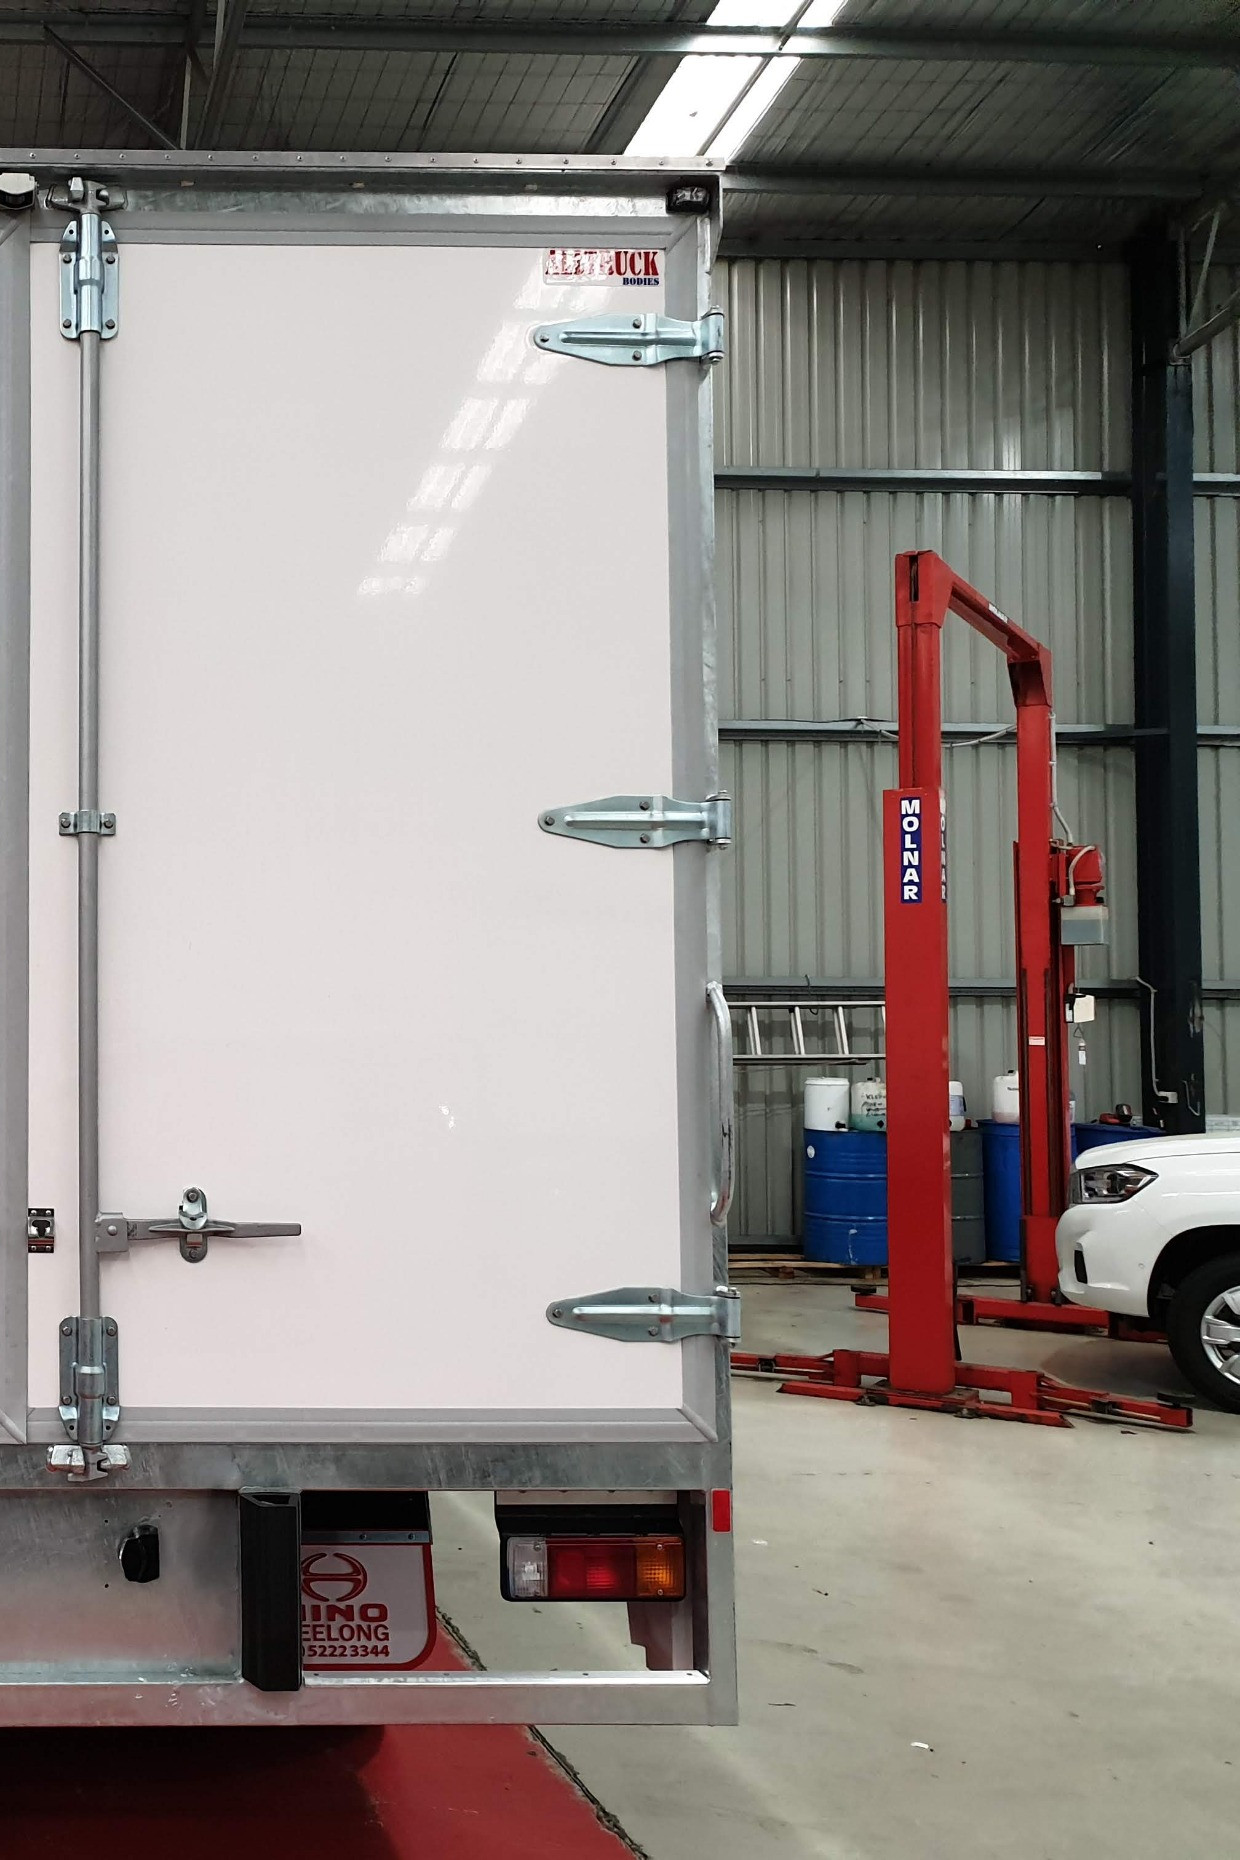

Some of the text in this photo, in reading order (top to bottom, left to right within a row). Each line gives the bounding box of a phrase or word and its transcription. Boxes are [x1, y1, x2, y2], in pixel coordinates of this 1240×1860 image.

[622, 277, 660, 286] BODIES
[901, 799, 921, 900] MOLNAR
[301, 1603, 389, 1622] INO
[301, 1624, 390, 1641] EELONG
